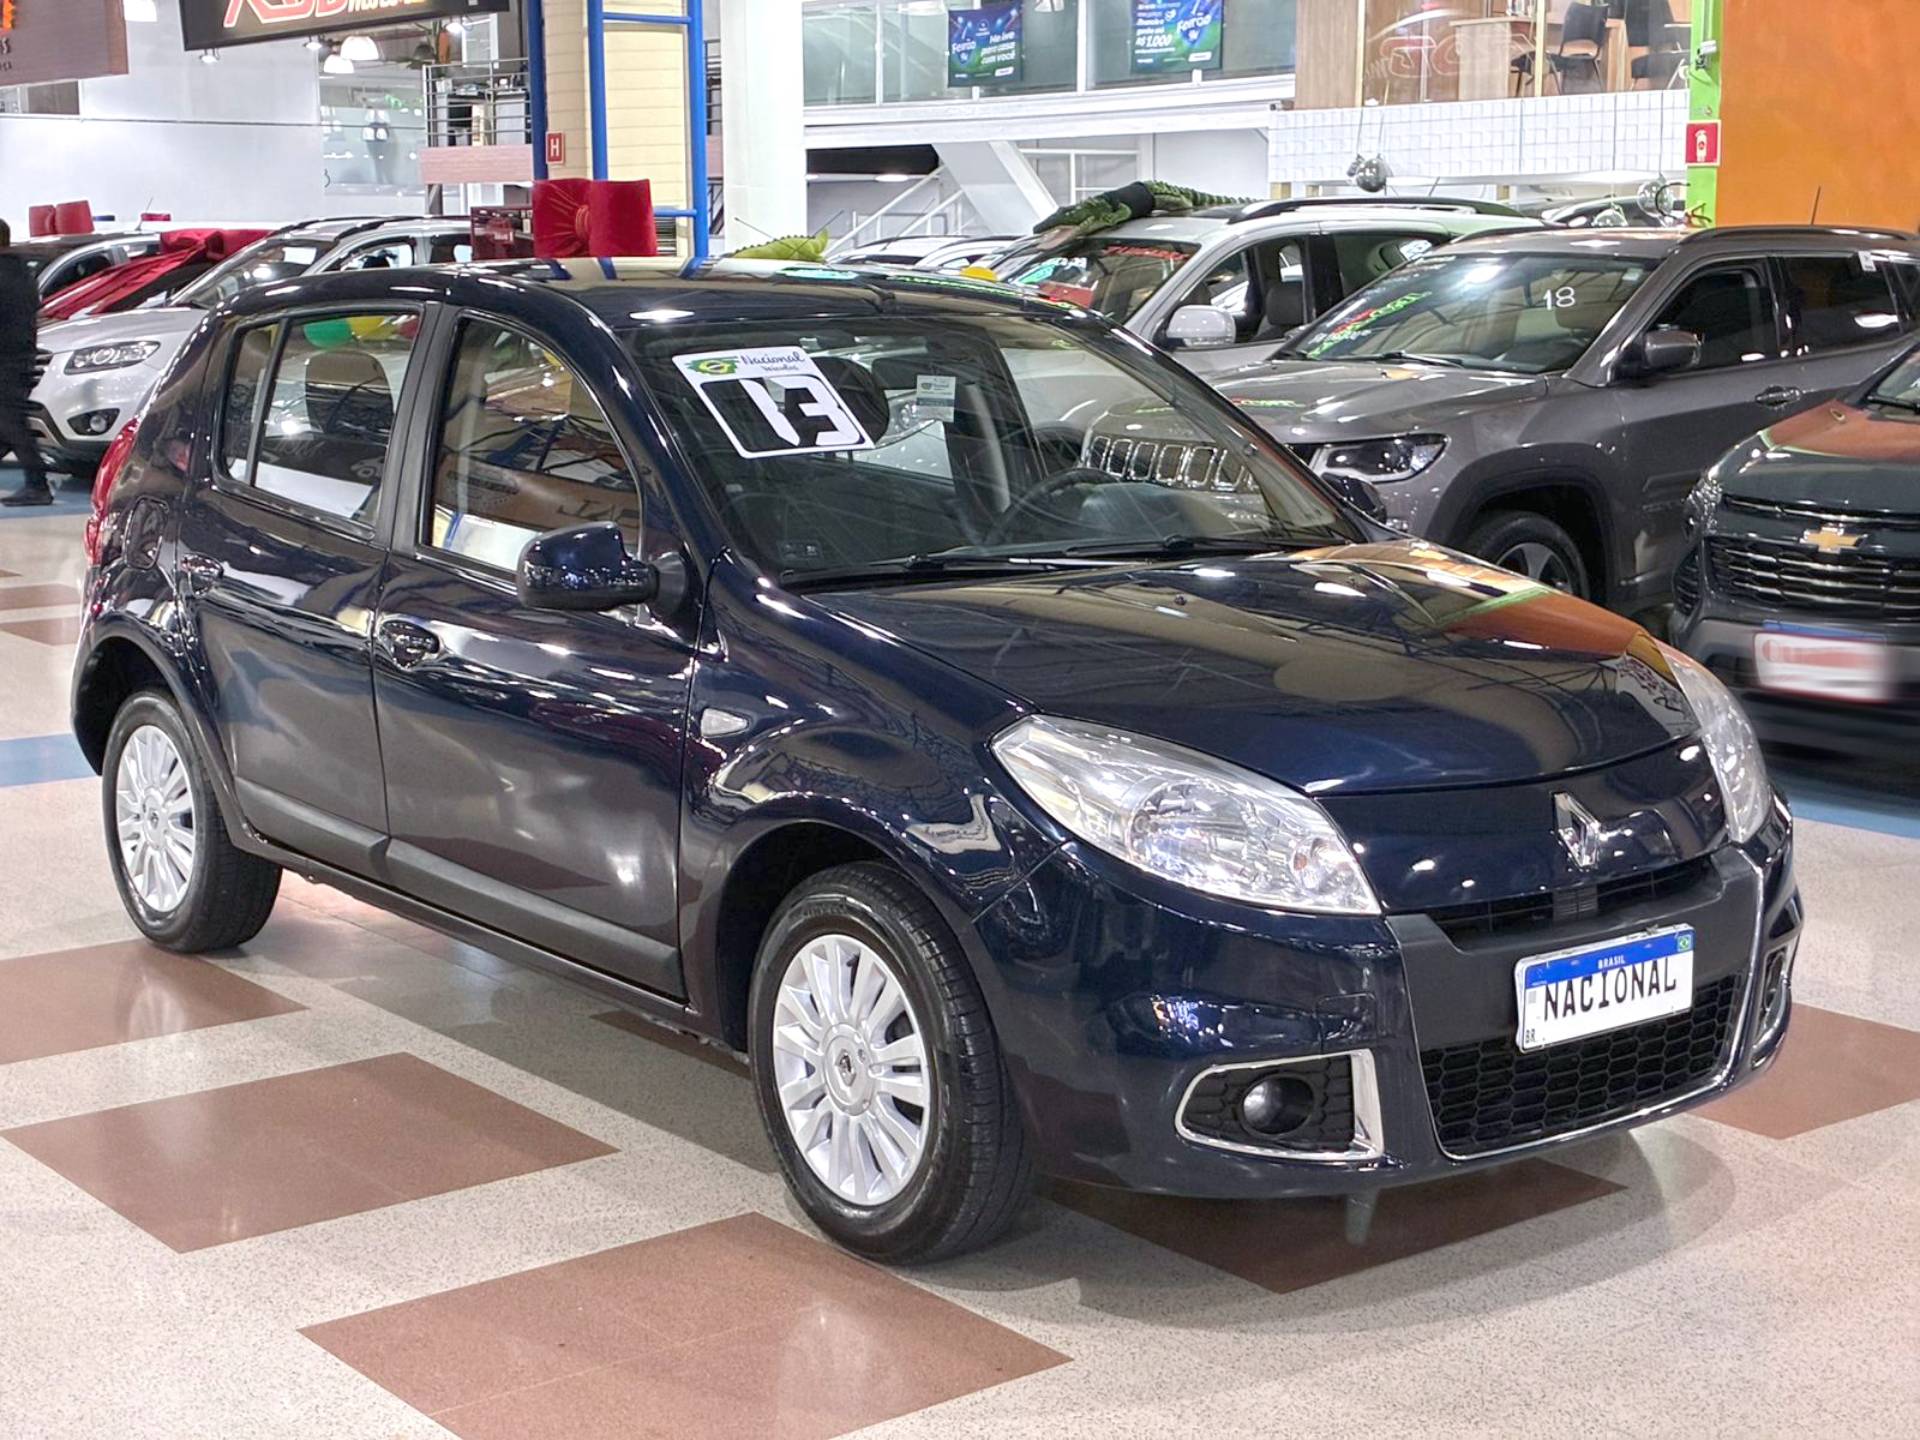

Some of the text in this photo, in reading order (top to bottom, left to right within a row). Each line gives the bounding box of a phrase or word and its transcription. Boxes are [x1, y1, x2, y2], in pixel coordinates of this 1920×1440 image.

[550, 137, 560, 157] H
[1543, 286, 1576, 311] 18
[740, 351, 806, 365] Nacional
[739, 375, 860, 446] 13
[1597, 954, 1626, 969] BRASIL
[1544, 957, 1677, 1022] NACIONAL
